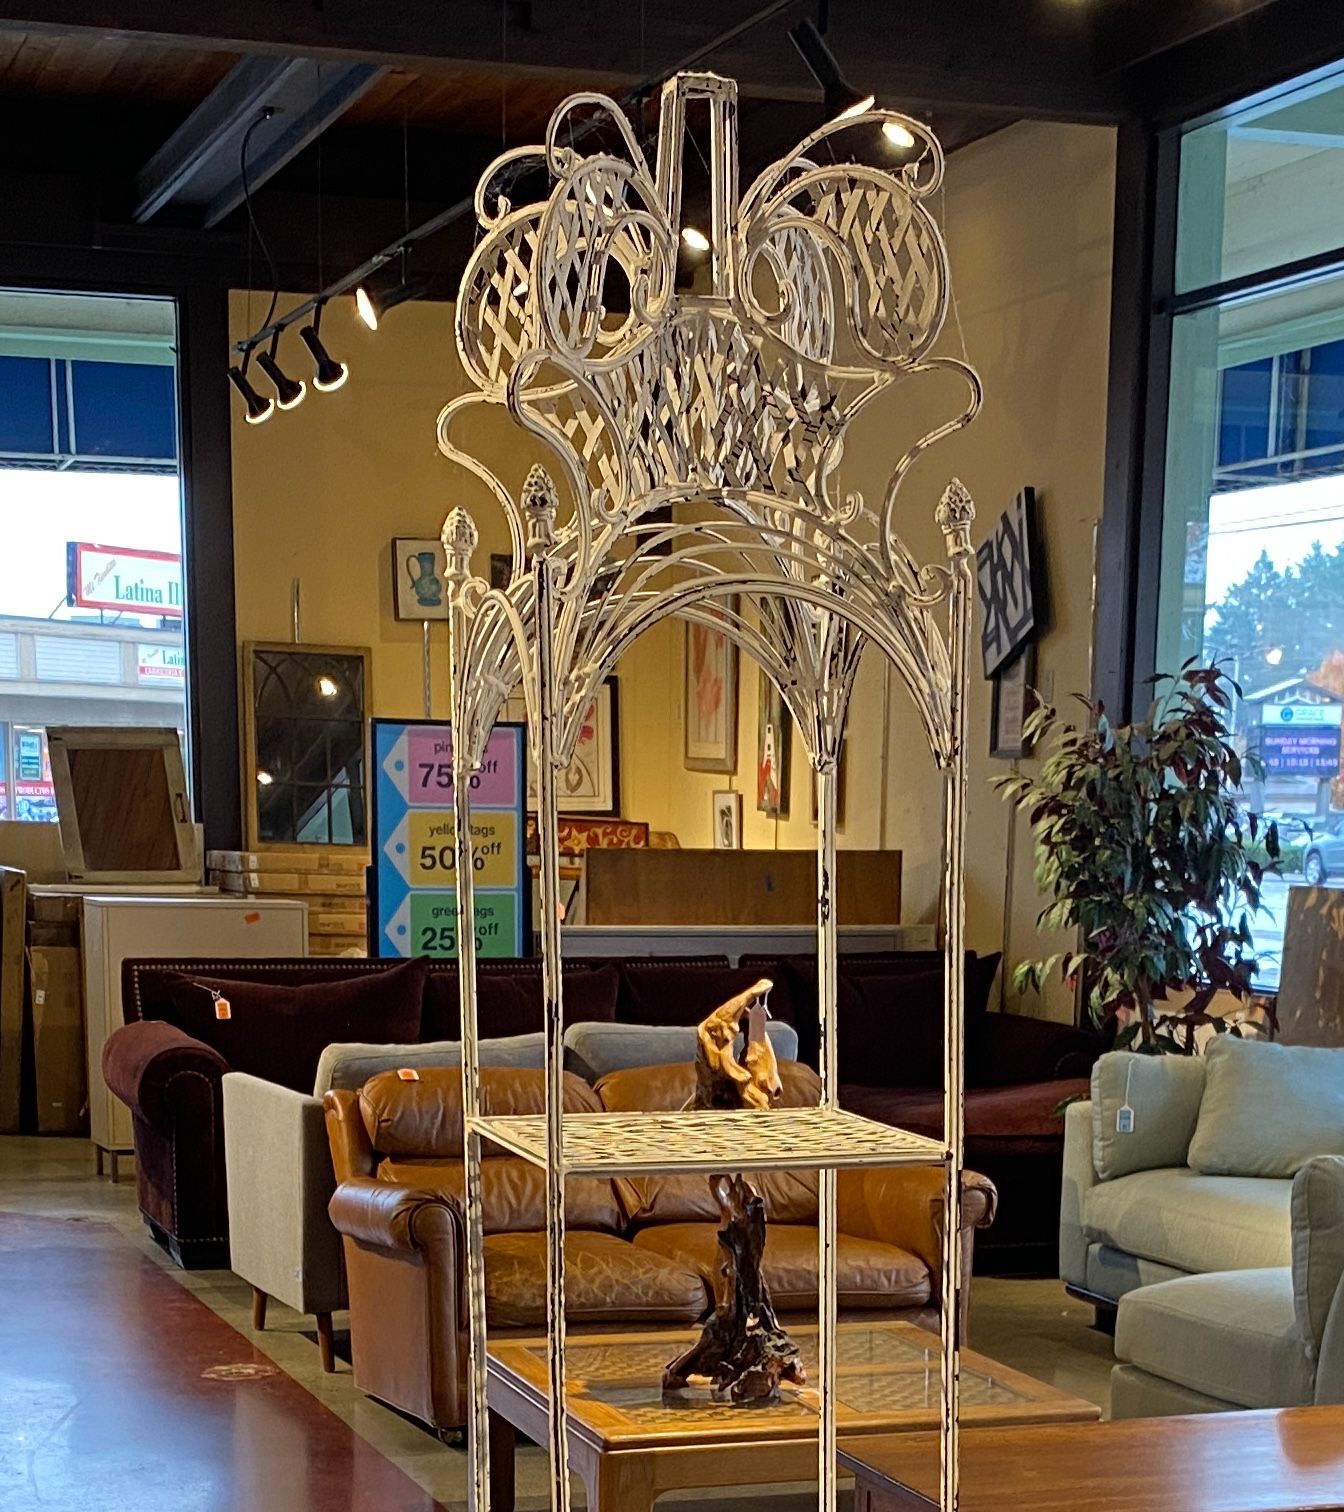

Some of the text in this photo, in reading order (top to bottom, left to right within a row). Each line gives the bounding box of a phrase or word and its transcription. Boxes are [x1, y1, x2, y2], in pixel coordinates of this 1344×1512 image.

[114, 575, 163, 604] Latina
[434, 741, 453, 755] pin
[479, 760, 498, 774] off
[429, 823, 496, 838] yello tags
[481, 842, 502, 855] off
[432, 907, 494, 919] gree ags
[478, 922, 499, 936] off
